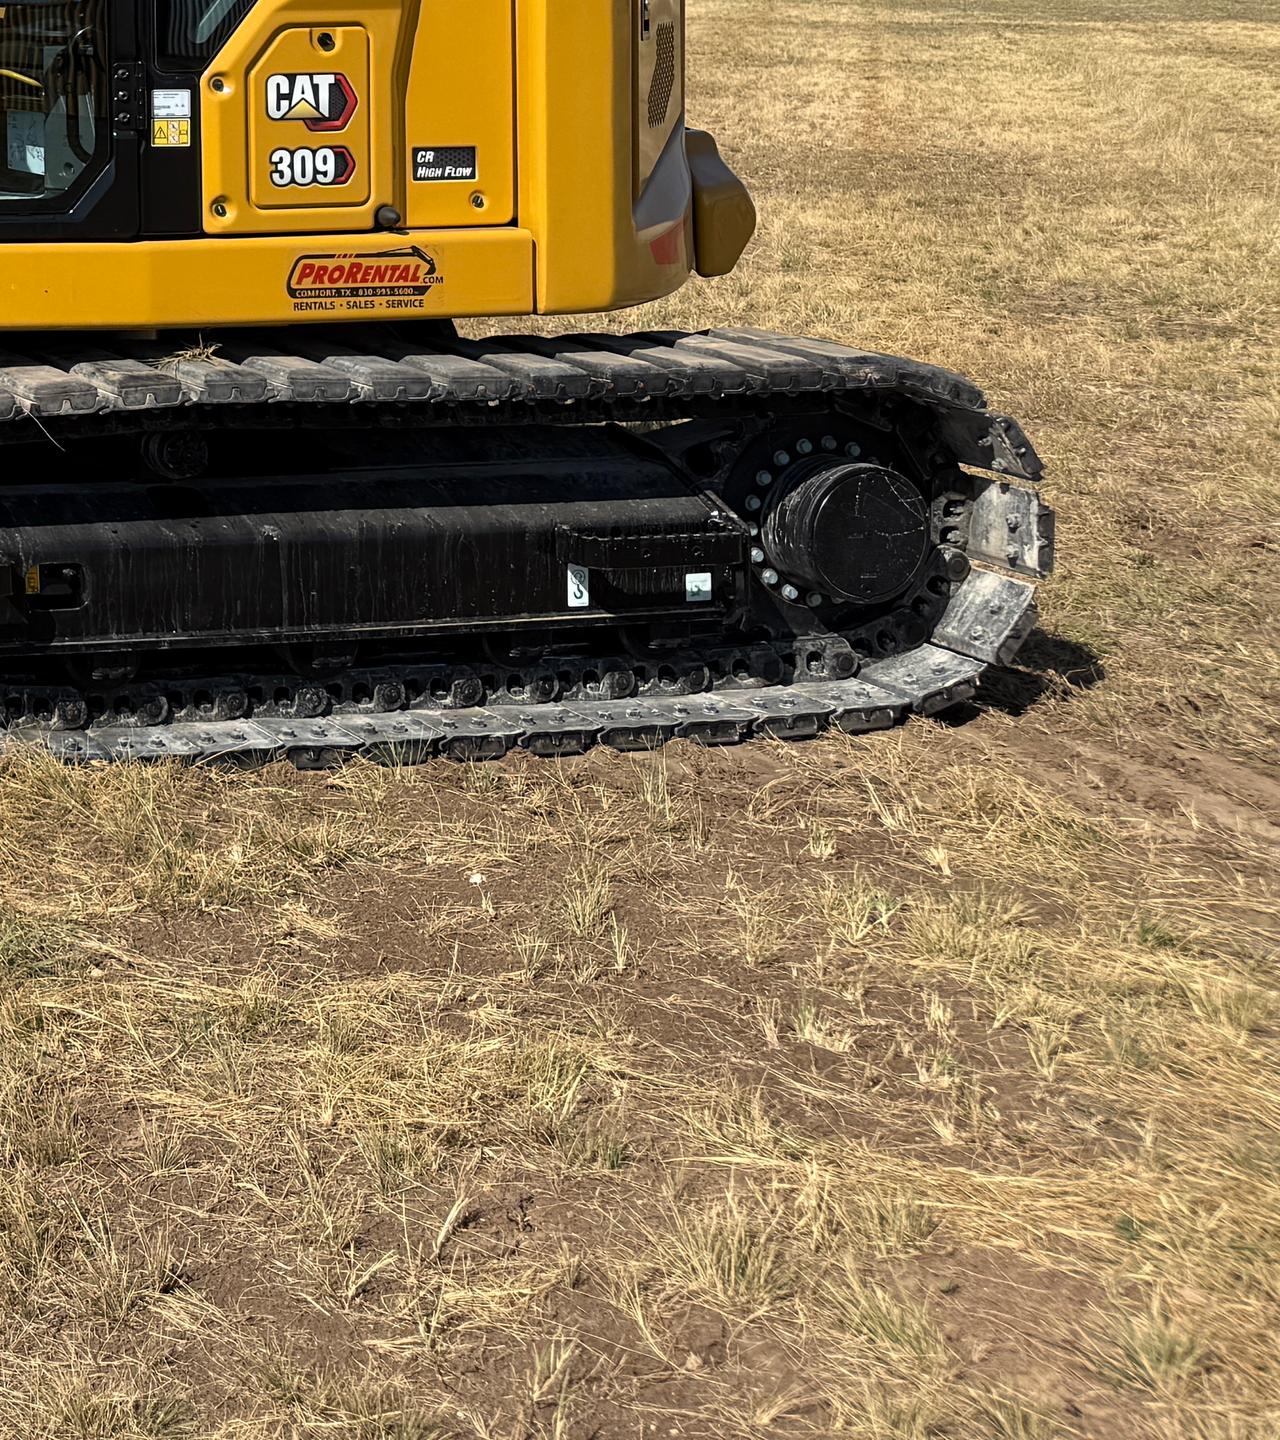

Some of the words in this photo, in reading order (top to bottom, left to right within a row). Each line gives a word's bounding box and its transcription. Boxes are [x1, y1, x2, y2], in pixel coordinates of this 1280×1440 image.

[266, 73, 336, 120] CAT
[416, 150, 435, 163] CR
[270, 148, 336, 185] 309
[340, 288, 352, 296] TX
[293, 301, 336, 311] RENTALS
[346, 300, 375, 309] SALES
[385, 299, 425, 308] SERVICE
